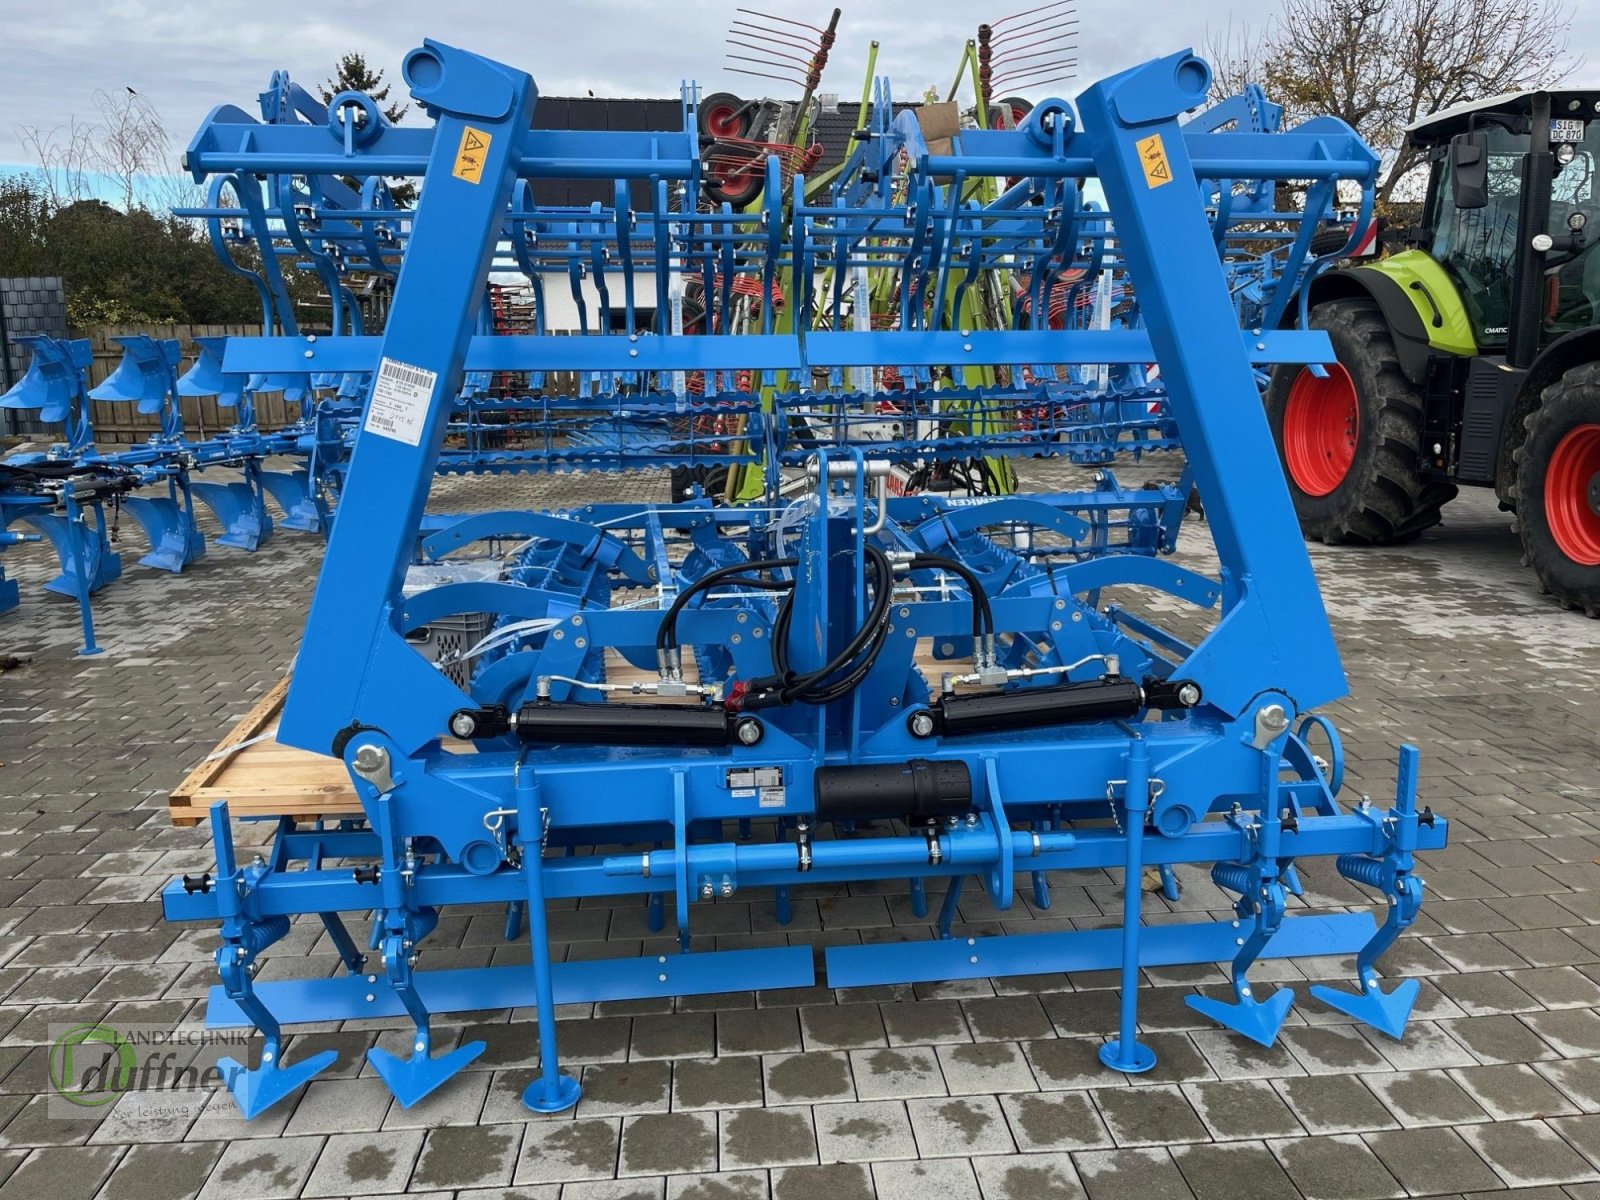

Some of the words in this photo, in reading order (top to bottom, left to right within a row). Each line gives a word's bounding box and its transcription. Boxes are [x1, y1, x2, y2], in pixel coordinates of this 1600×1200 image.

[1557, 121, 1573, 130] SIG
[1553, 130, 1563, 138] DC
[1566, 130, 1582, 138] 870
[946, 497, 1004, 507] EMKEN
